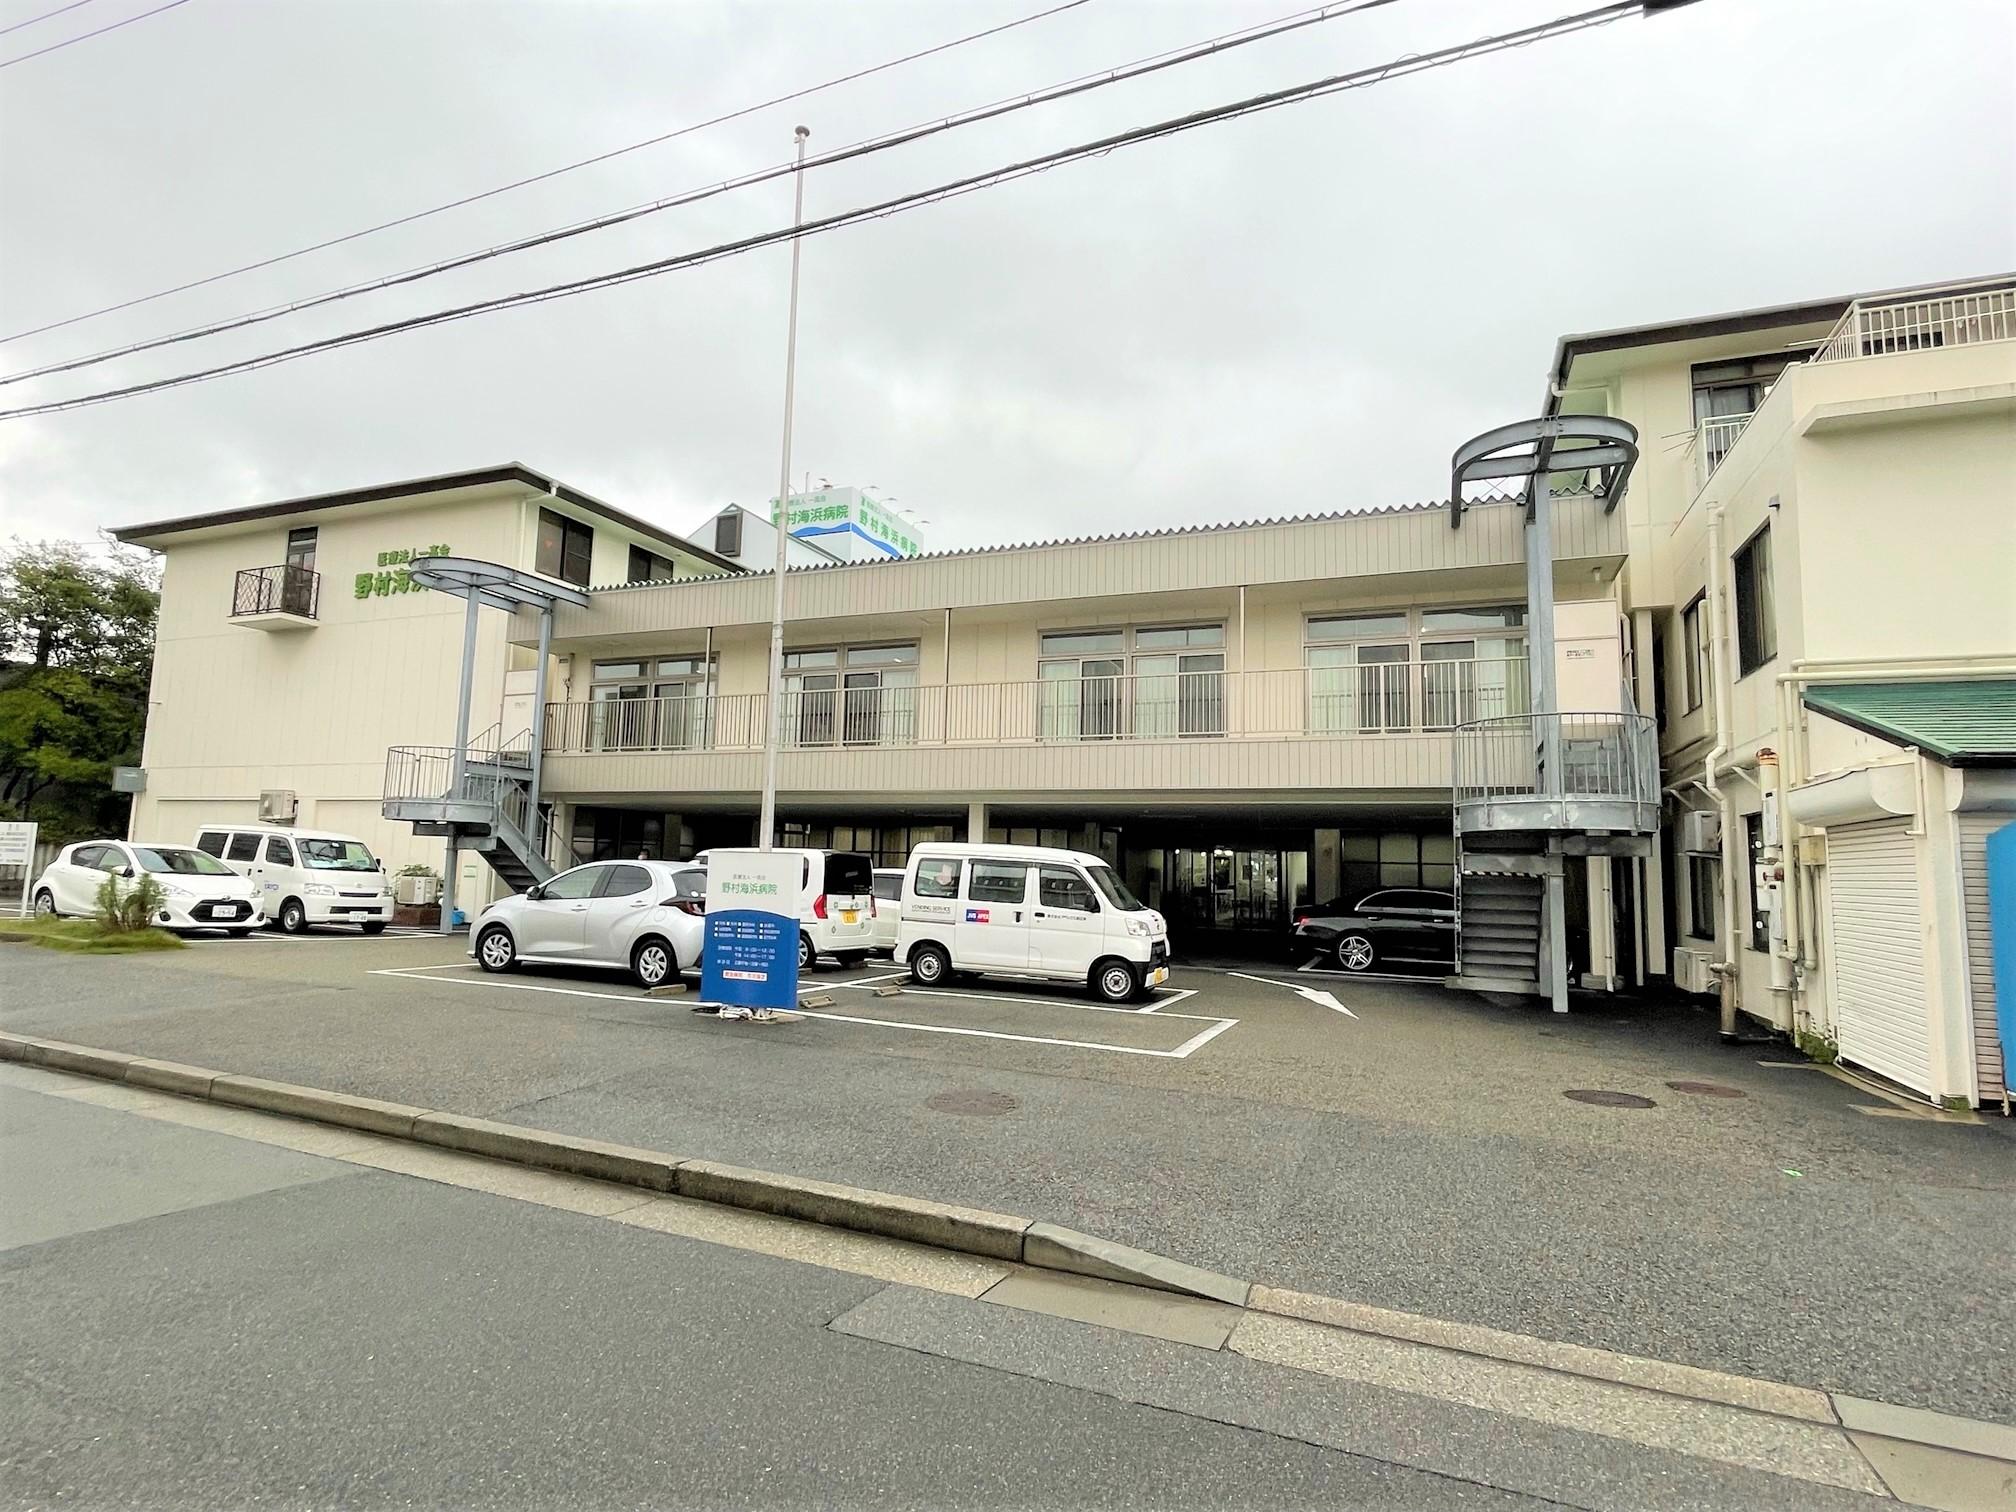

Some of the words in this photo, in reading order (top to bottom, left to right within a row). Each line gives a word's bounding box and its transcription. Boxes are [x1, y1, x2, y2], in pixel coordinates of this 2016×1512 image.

[354, 568, 429, 600] 野村海
[722, 882, 777, 895] 野村海浜病院
